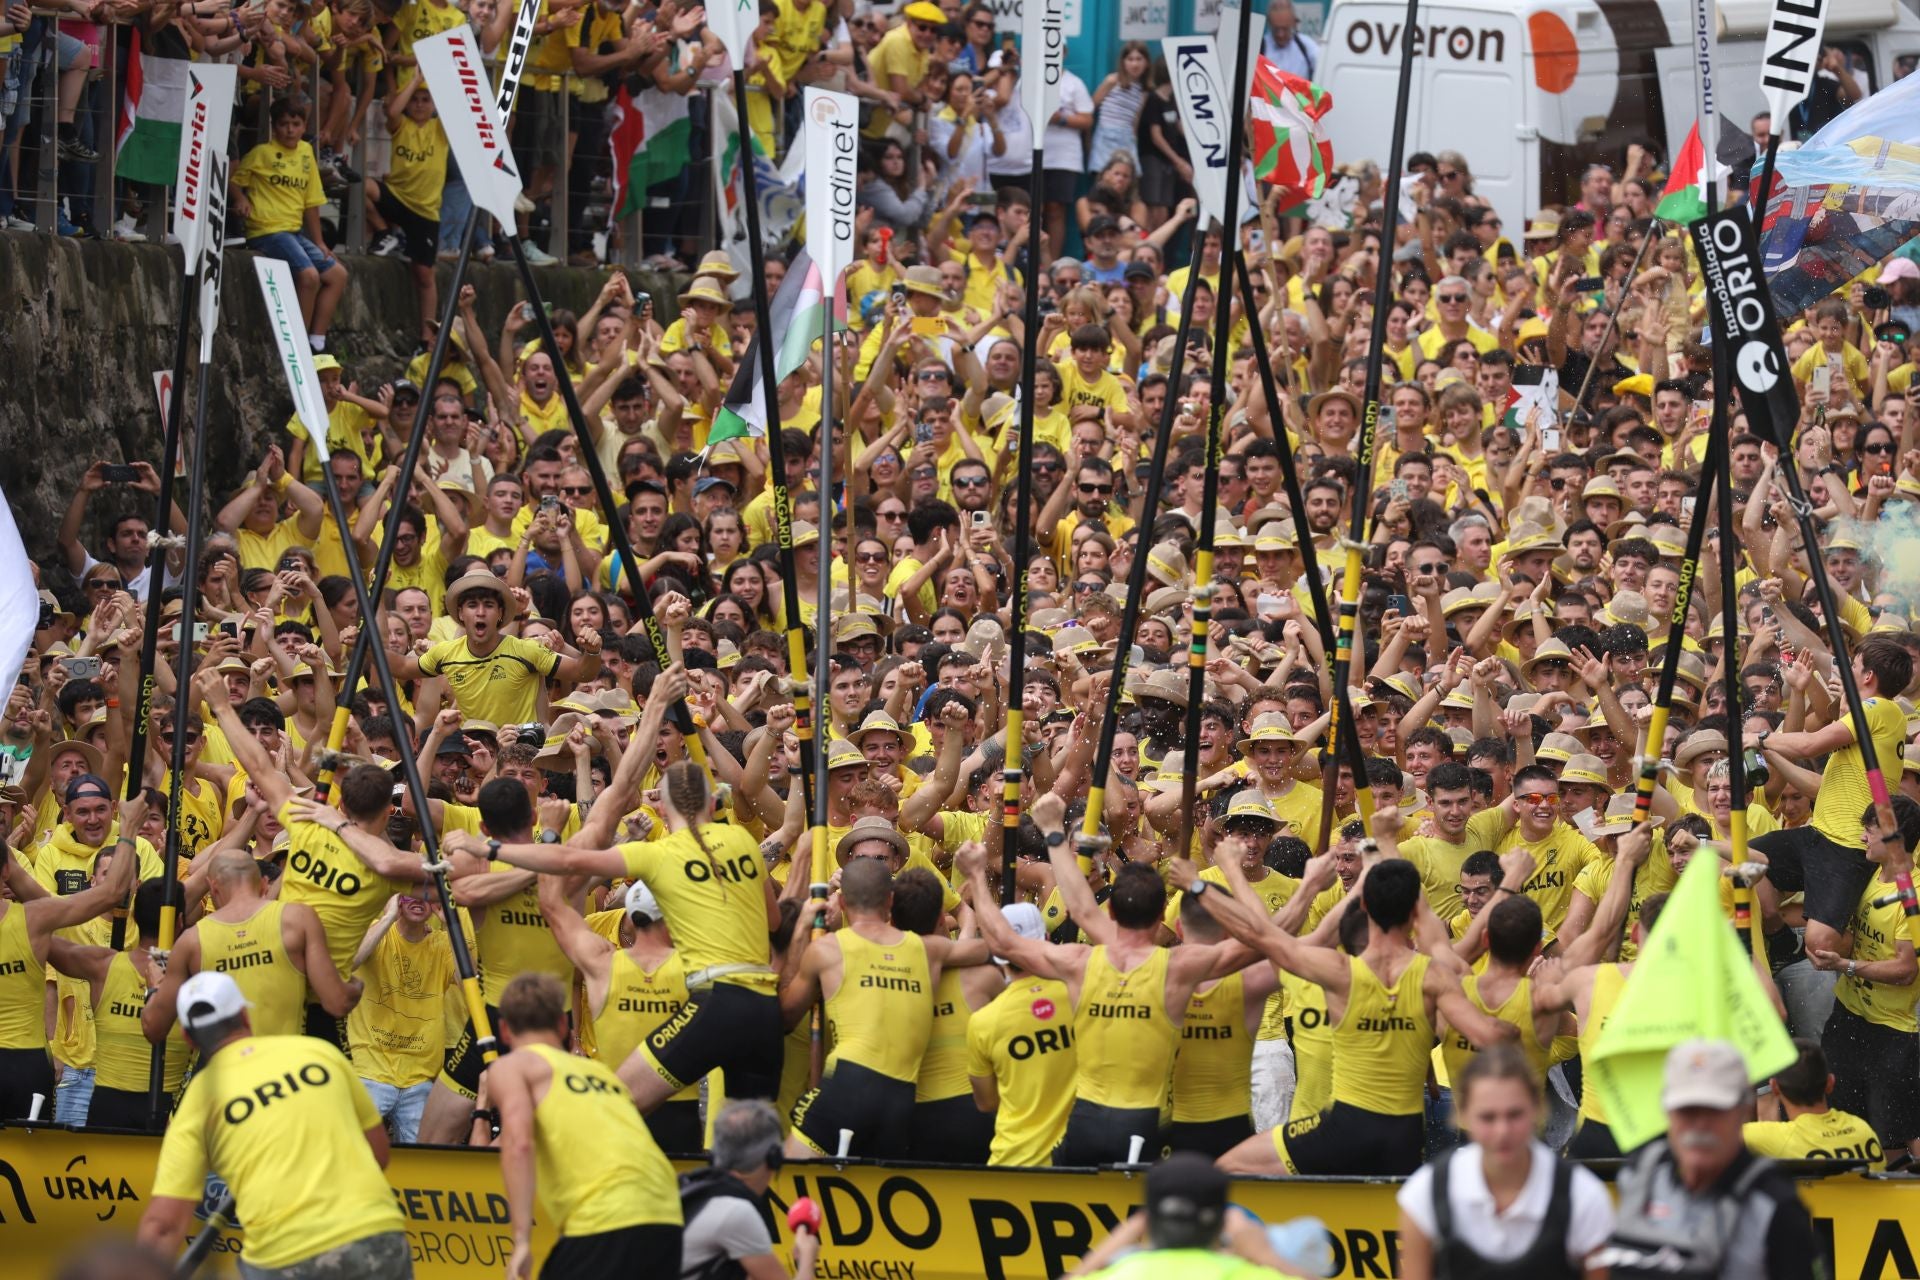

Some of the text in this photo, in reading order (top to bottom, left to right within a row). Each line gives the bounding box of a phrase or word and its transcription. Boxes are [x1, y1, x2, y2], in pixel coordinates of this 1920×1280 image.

[1347, 20, 1504, 62] overon
[447, 32, 496, 149] Telleria
[180, 101, 207, 221] Telleria
[830, 119, 854, 240] aldinet
[1713, 218, 1765, 332] ORIO
[1360, 400, 1378, 465] SAGARDI
[774, 485, 792, 550] SAGARDI
[1671, 558, 1696, 625] SAGARDI
[645, 616, 674, 671] SAGARD
[138, 673, 155, 736] SAGARDI
[290, 850, 361, 896] ORIO
[500, 908, 550, 929] aum
[215, 950, 274, 973] auma
[859, 974, 922, 994] auma
[618, 998, 683, 1014] auma
[651, 1000, 700, 1050] ORIALKI
[1088, 1002, 1152, 1020] auma
[1007, 1024, 1076, 1061] ORI
[223, 1062, 332, 1126] ORIO
[44, 1176, 140, 1202] URMA
